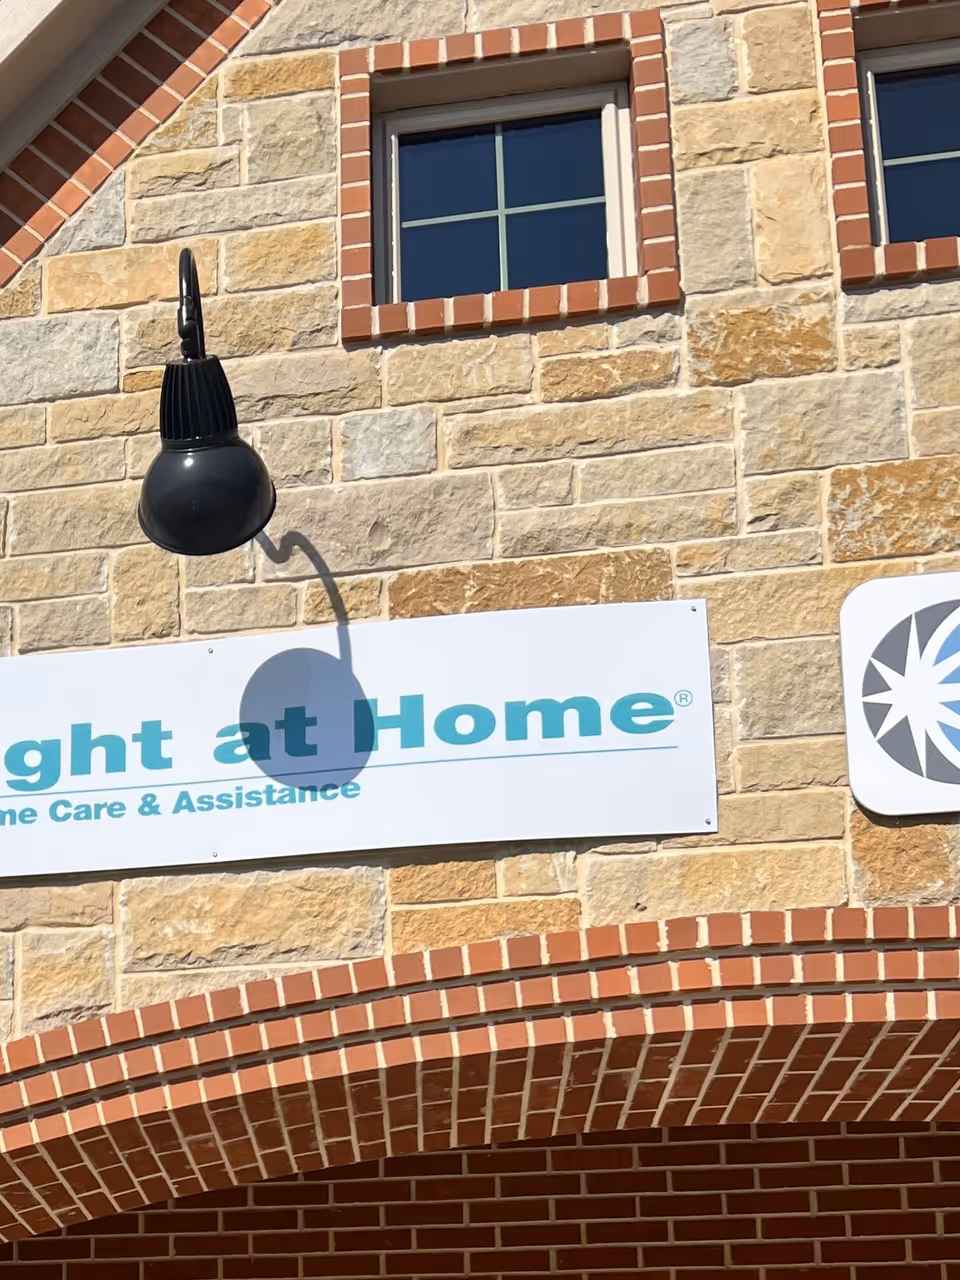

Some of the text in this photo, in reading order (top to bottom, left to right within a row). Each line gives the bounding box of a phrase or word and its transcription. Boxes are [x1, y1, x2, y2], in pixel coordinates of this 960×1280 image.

[213, 705, 318, 764] at
[49, 799, 125, 823] Care
[138, 793, 163, 816] &
[172, 780, 361, 814] Assistance
